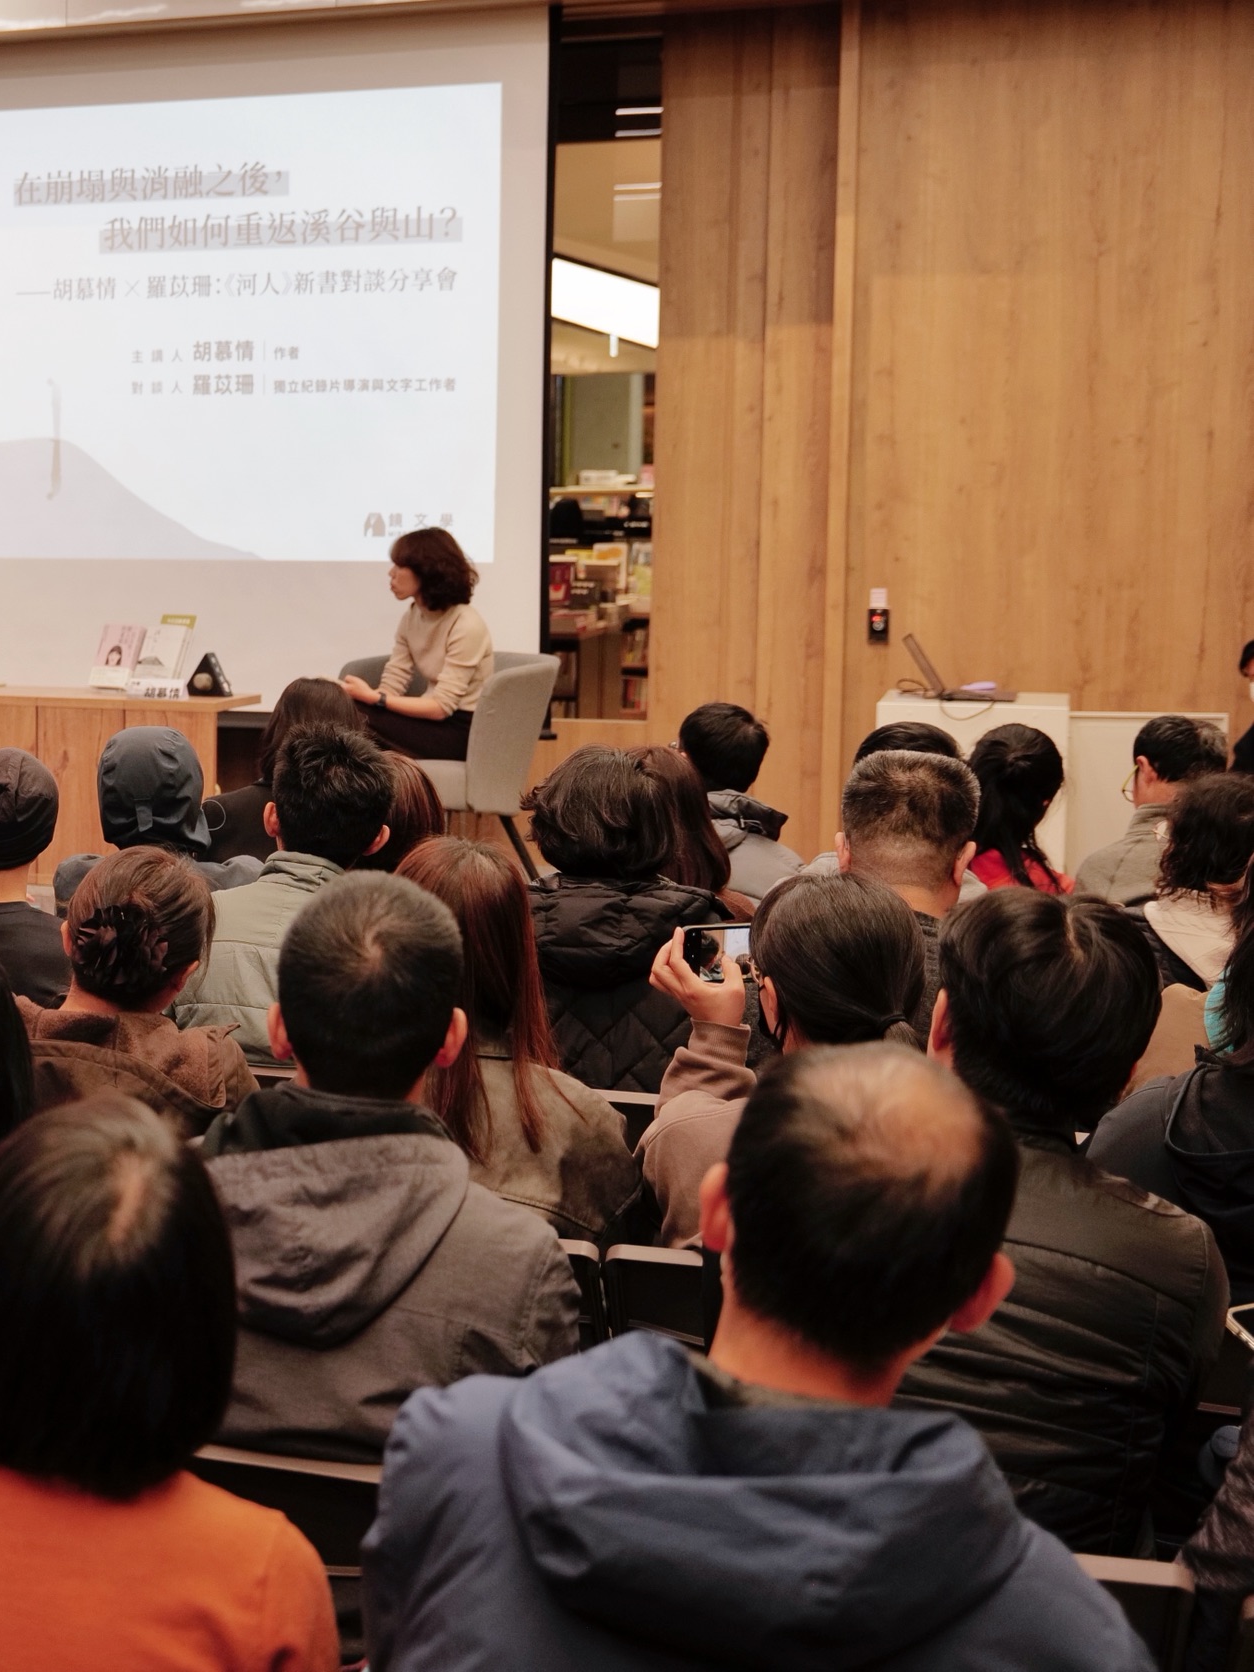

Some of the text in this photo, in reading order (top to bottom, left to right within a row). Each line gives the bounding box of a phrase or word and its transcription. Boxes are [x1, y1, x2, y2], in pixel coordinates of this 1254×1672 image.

[13, 161, 283, 206] 在崩塌與消融之後，
[103, 206, 458, 251] 我們如何重返溪谷與山？
[193, 340, 254, 362] 胡慕情
[273, 346, 299, 360] 作者
[193, 374, 254, 395] 羅苡珊
